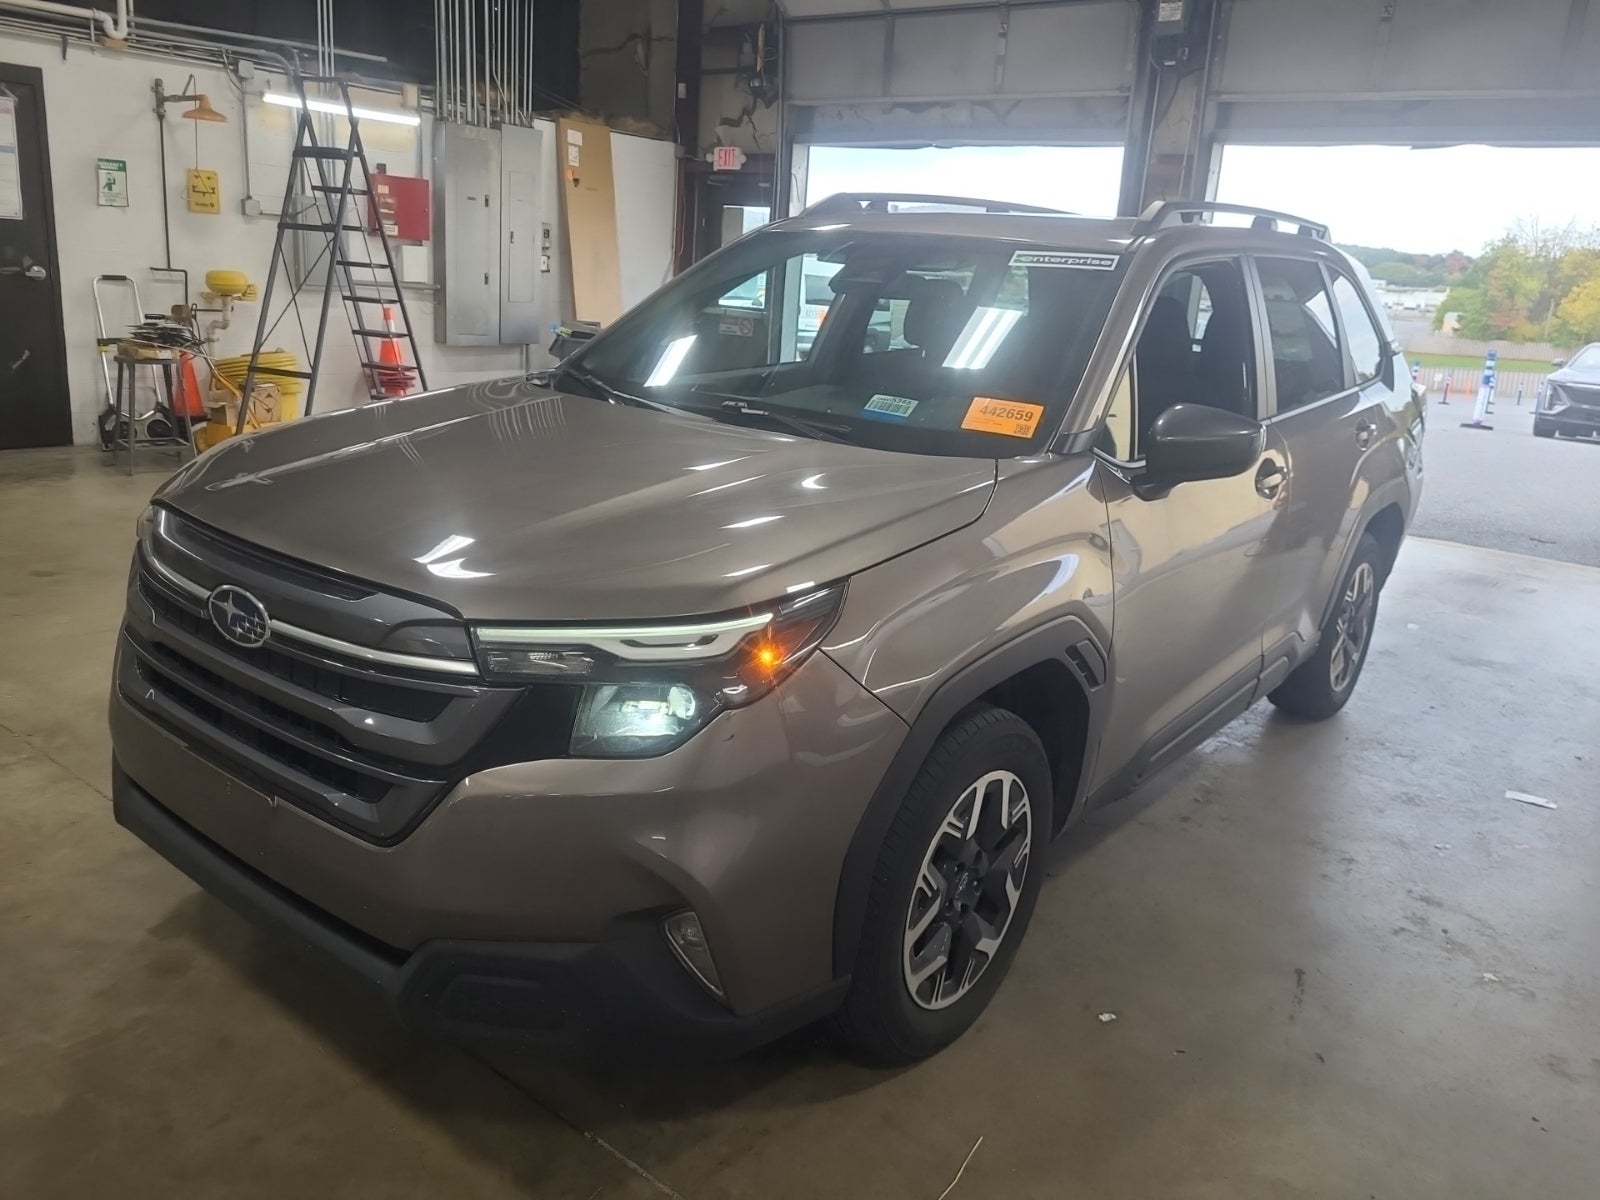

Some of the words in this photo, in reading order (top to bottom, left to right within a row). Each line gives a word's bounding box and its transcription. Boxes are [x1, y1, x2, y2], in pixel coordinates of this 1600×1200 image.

[717, 148, 737, 168] EXIT
[1017, 255, 1112, 266] enterprise
[979, 405, 1034, 422] 442659
